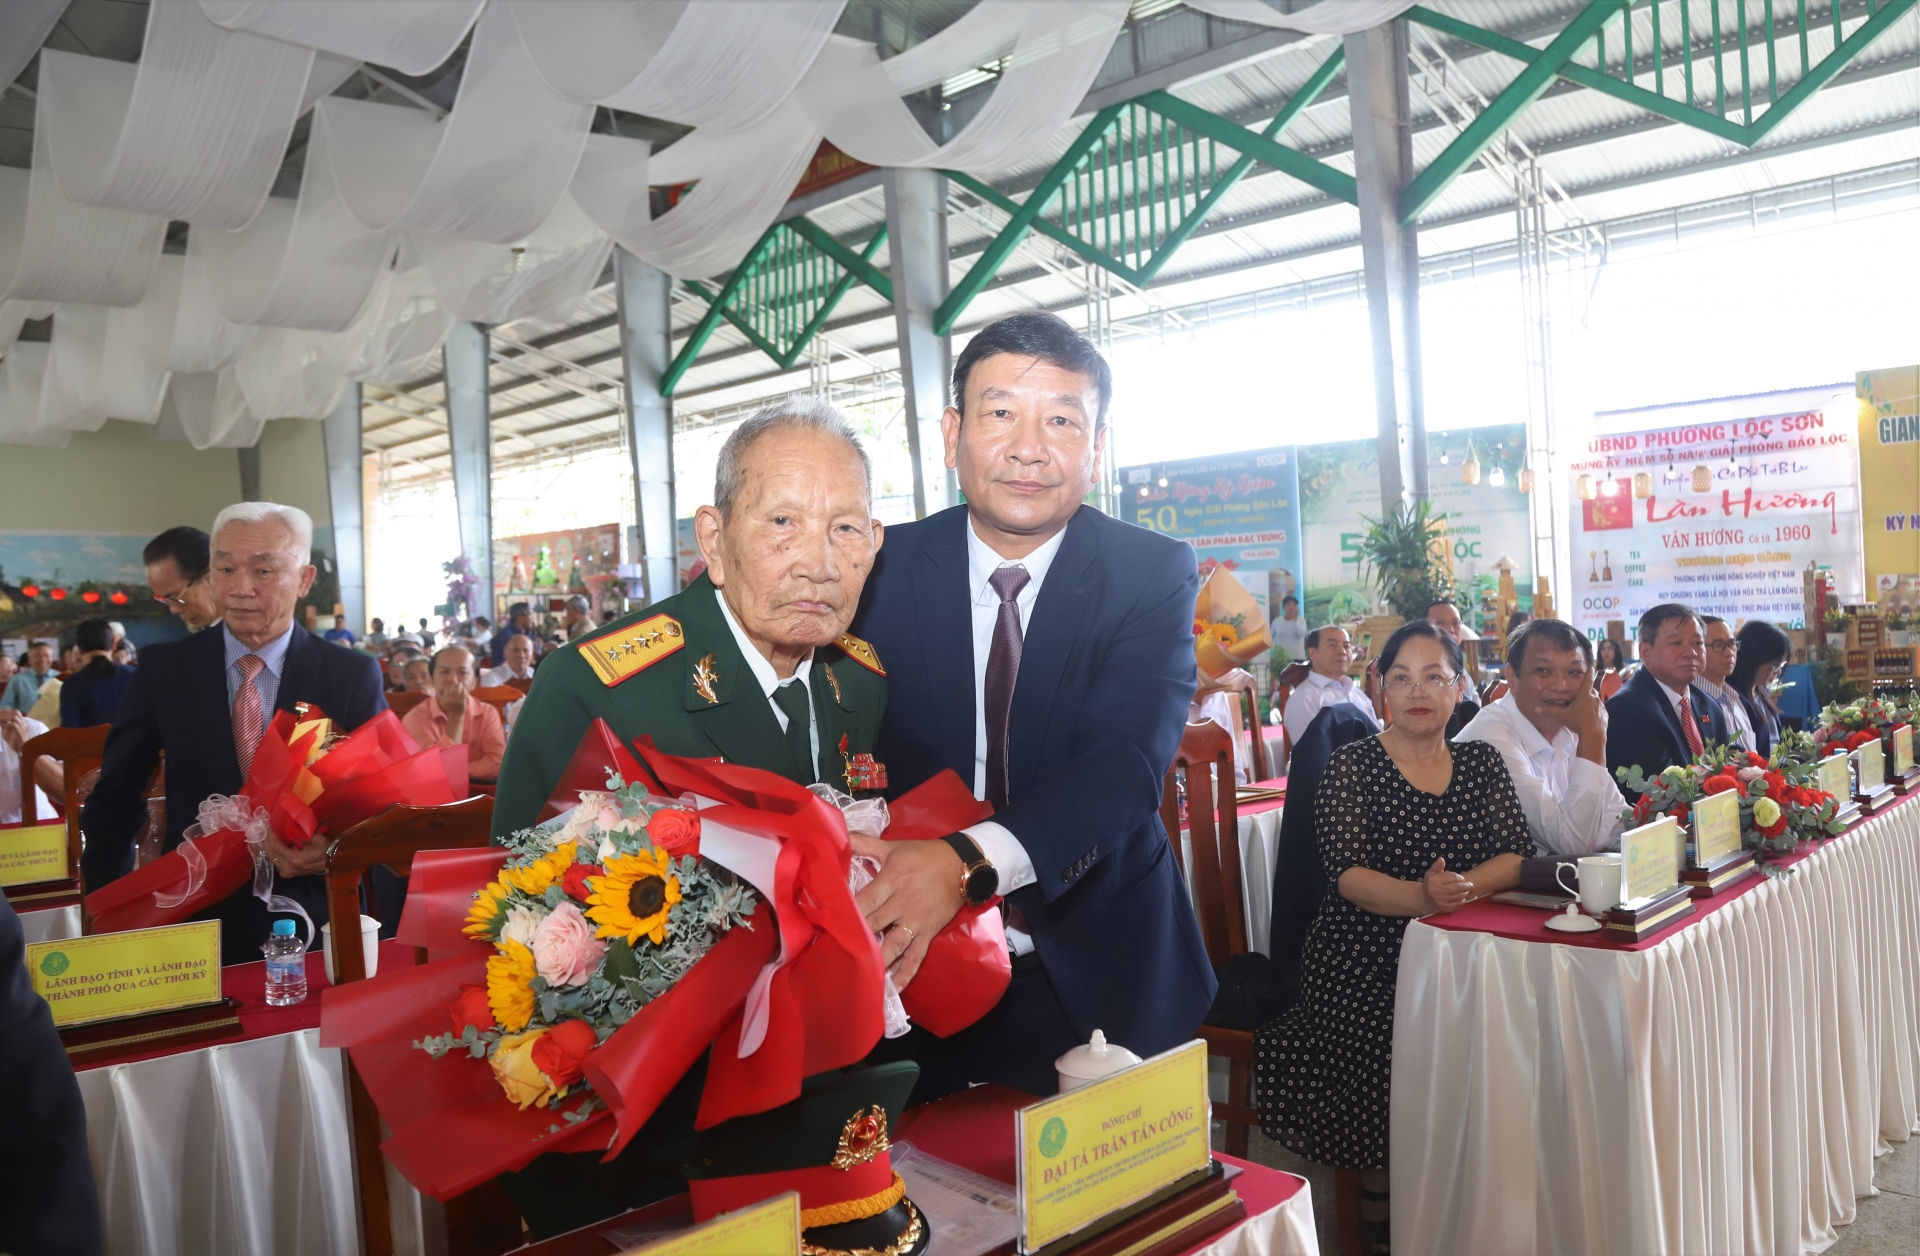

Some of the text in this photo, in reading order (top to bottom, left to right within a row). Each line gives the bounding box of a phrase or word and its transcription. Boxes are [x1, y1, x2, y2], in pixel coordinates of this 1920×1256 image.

[1588, 435, 1637, 453] UBND
[1733, 417, 1773, 439] LỘC
[1781, 411, 1824, 432] SƠN
[1879, 416, 1920, 444] GIAN
[1739, 440, 1784, 455] PHÓNG
[1788, 436, 1816, 449] BẢO
[1820, 433, 1847, 446] LỘC
[1136, 505, 1178, 532] 50
[1775, 524, 1812, 542] 1960
[1454, 537, 1483, 563] ỘC
[1629, 551, 1640, 559] TEA
[1624, 564, 1646, 574] COFFEE
[1782, 569, 1795, 578] NAM
[1628, 579, 1643, 587] CAKE
[1583, 596, 1620, 610] OCOP
[45, 957, 208, 990] LÃNH ĐẠO TỈNH VÀ LÃNH ĐẠO
[45, 985, 86, 1002] THÀNH
[88, 982, 112, 996] PHỐ
[113, 981, 138, 995] QUA
[139, 975, 162, 989] CÁC
[164, 971, 191, 986] THỜI
[1126, 1104, 1142, 1121] CHÍ
[1043, 1160, 1068, 1184] ĐẠI
[1071, 1147, 1089, 1171] TÁ
[1092, 1133, 1128, 1162] TRẦN
[1159, 1105, 1194, 1133] CÔNG
